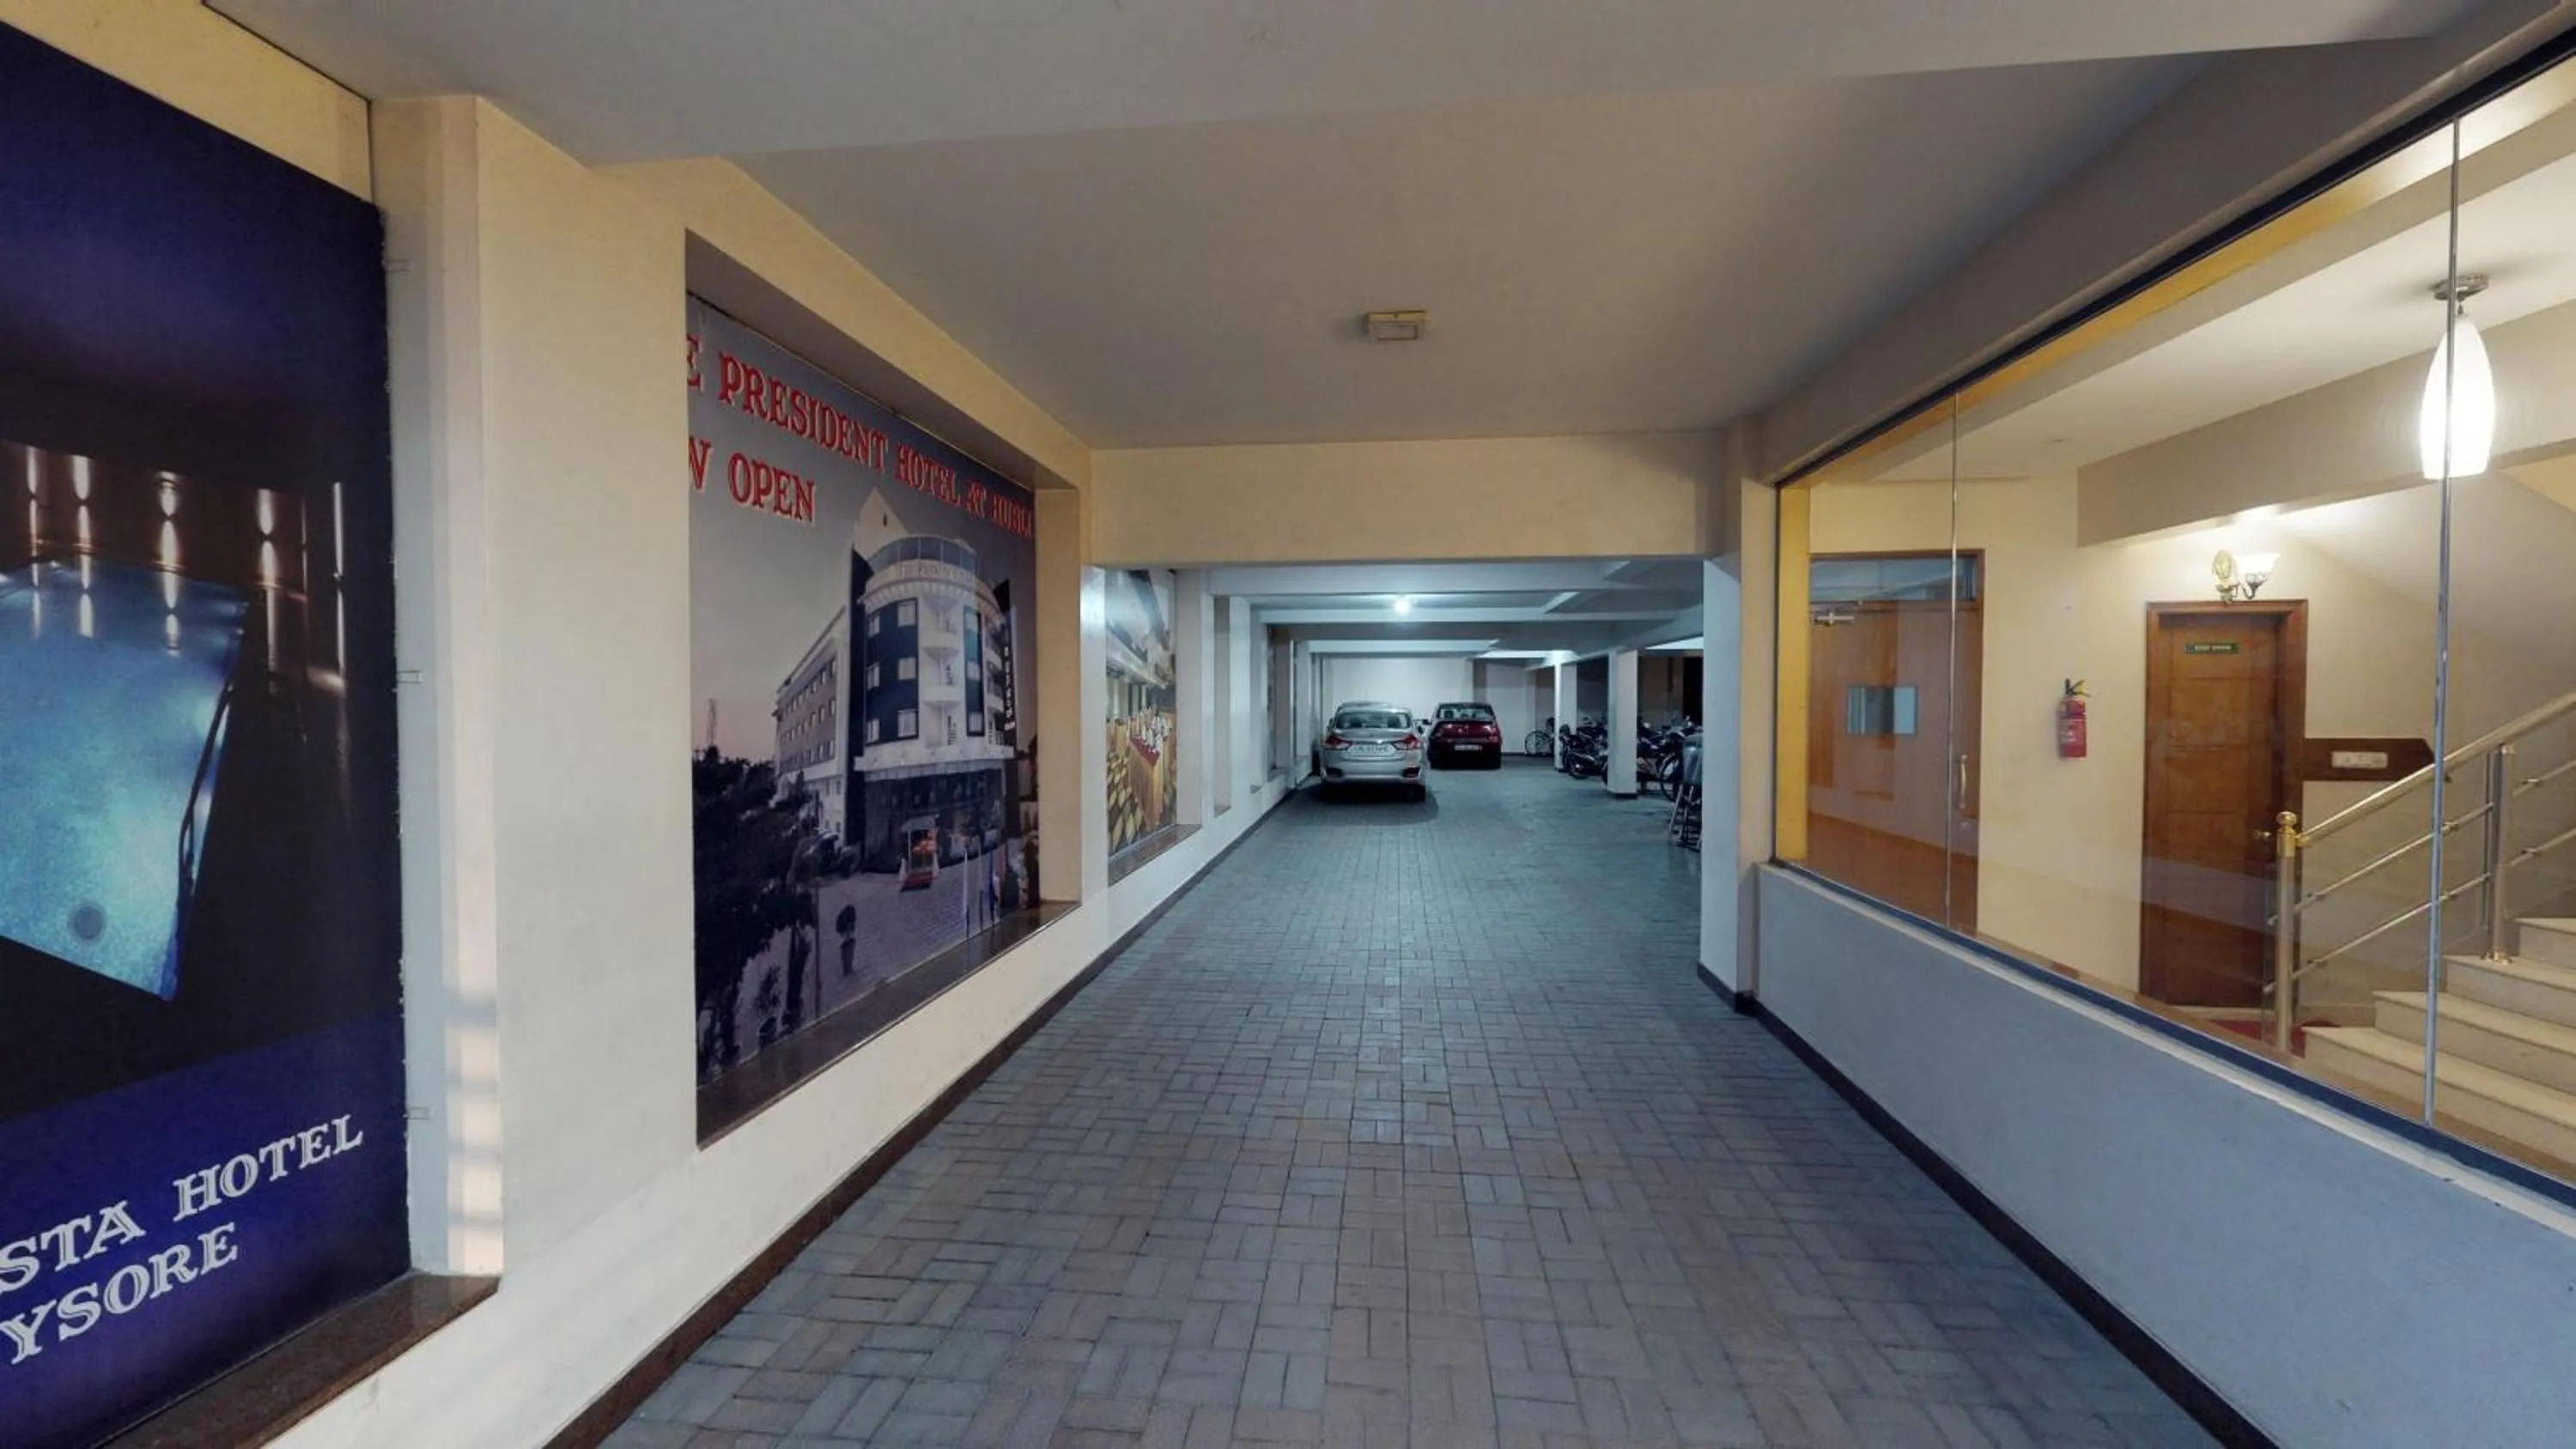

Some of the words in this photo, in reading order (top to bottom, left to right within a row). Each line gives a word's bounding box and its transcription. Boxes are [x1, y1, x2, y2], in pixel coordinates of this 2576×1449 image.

[718, 351, 889, 475] PRESIDENT
[894, 443, 961, 506] HOTEL
[965, 481, 987, 520] AT
[727, 452, 816, 526] OPEN
[173, 1114, 364, 1222] HOTEL
[0, 1222, 239, 1365] YSORE
